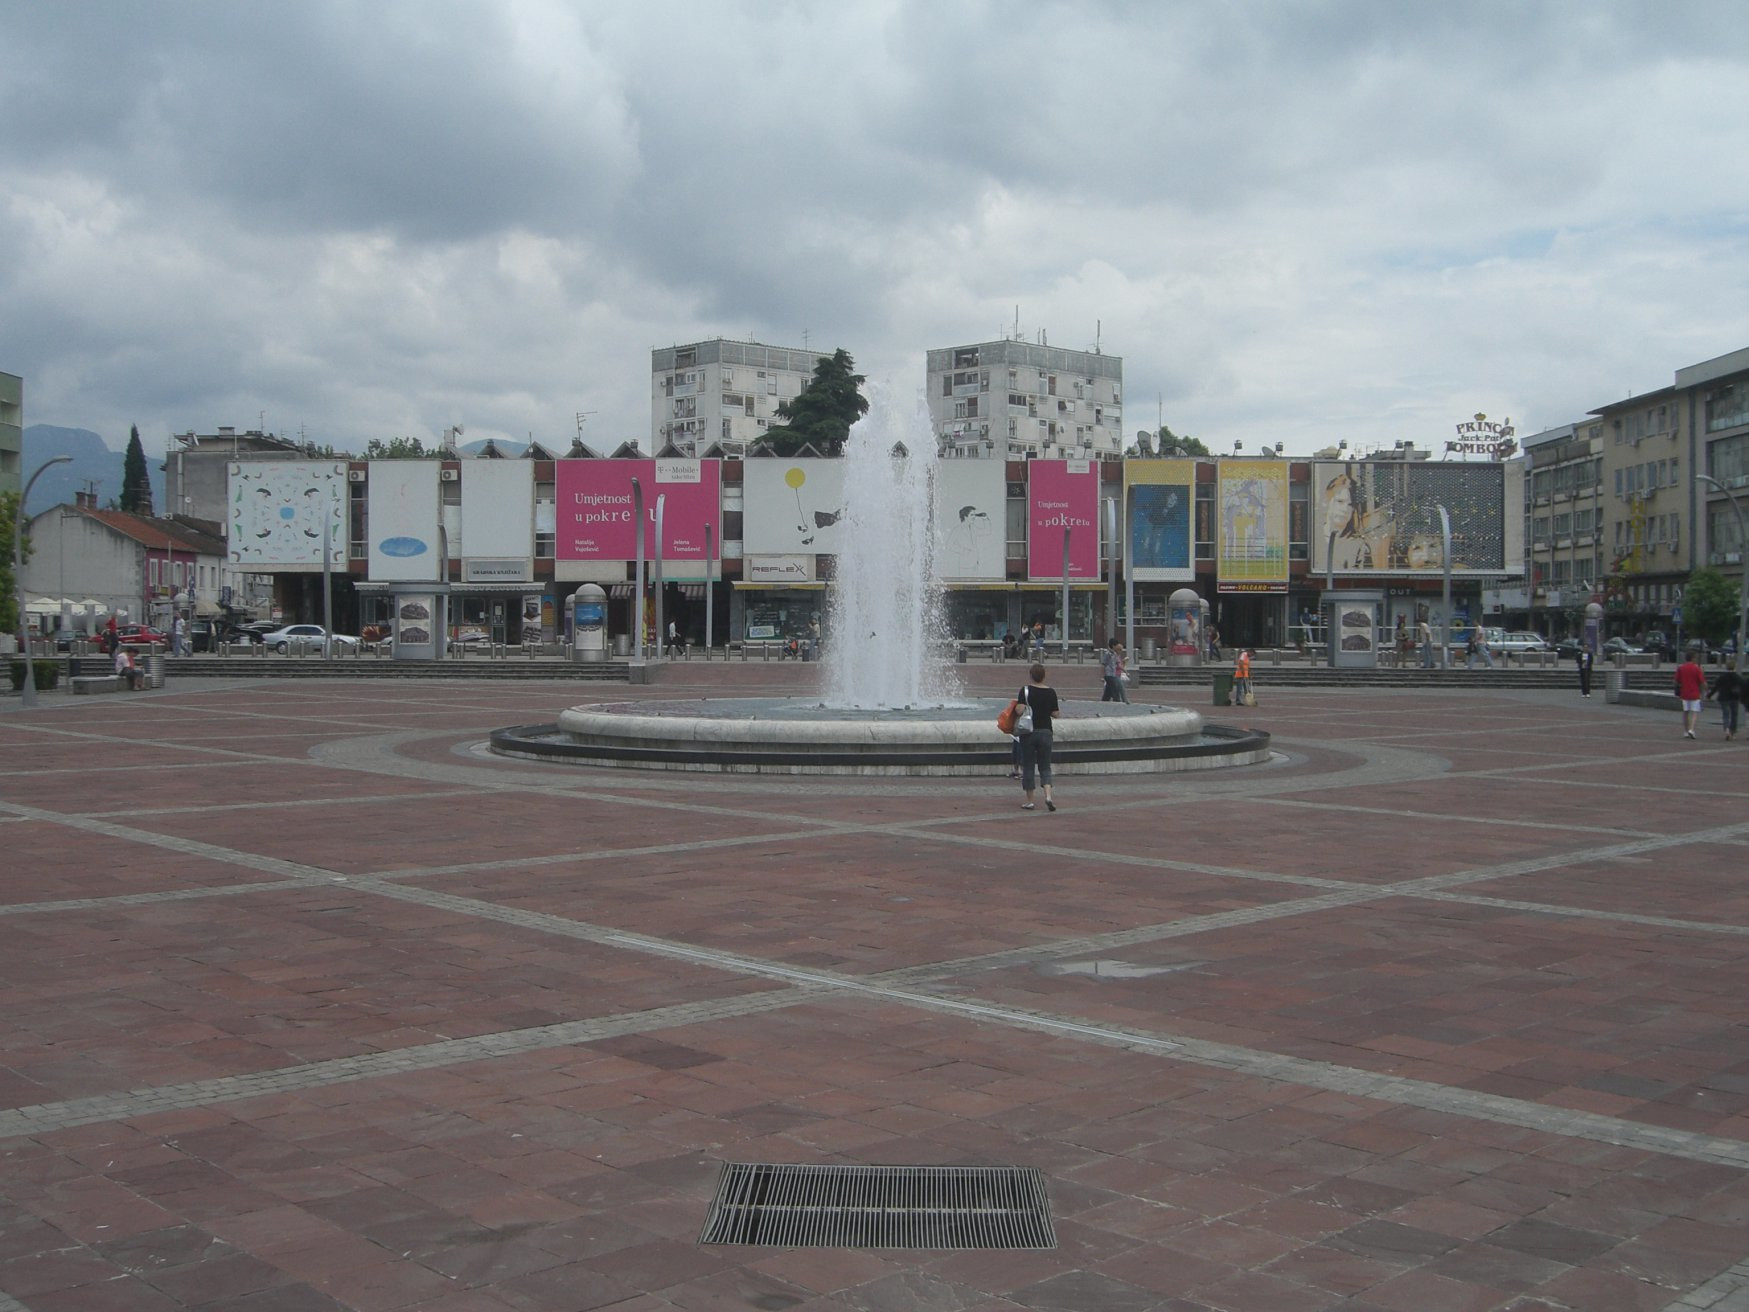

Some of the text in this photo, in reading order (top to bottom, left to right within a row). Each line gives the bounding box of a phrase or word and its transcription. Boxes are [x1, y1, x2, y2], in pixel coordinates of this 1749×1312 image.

[1446, 442, 1516, 457] OMBO
[575, 493, 632, 505] Umjetnost
[1037, 501, 1069, 510] Umjetnost
[575, 509, 658, 523] u pokreu
[1045, 512, 1090, 527] pokretu
[752, 562, 806, 577] REFLEX
